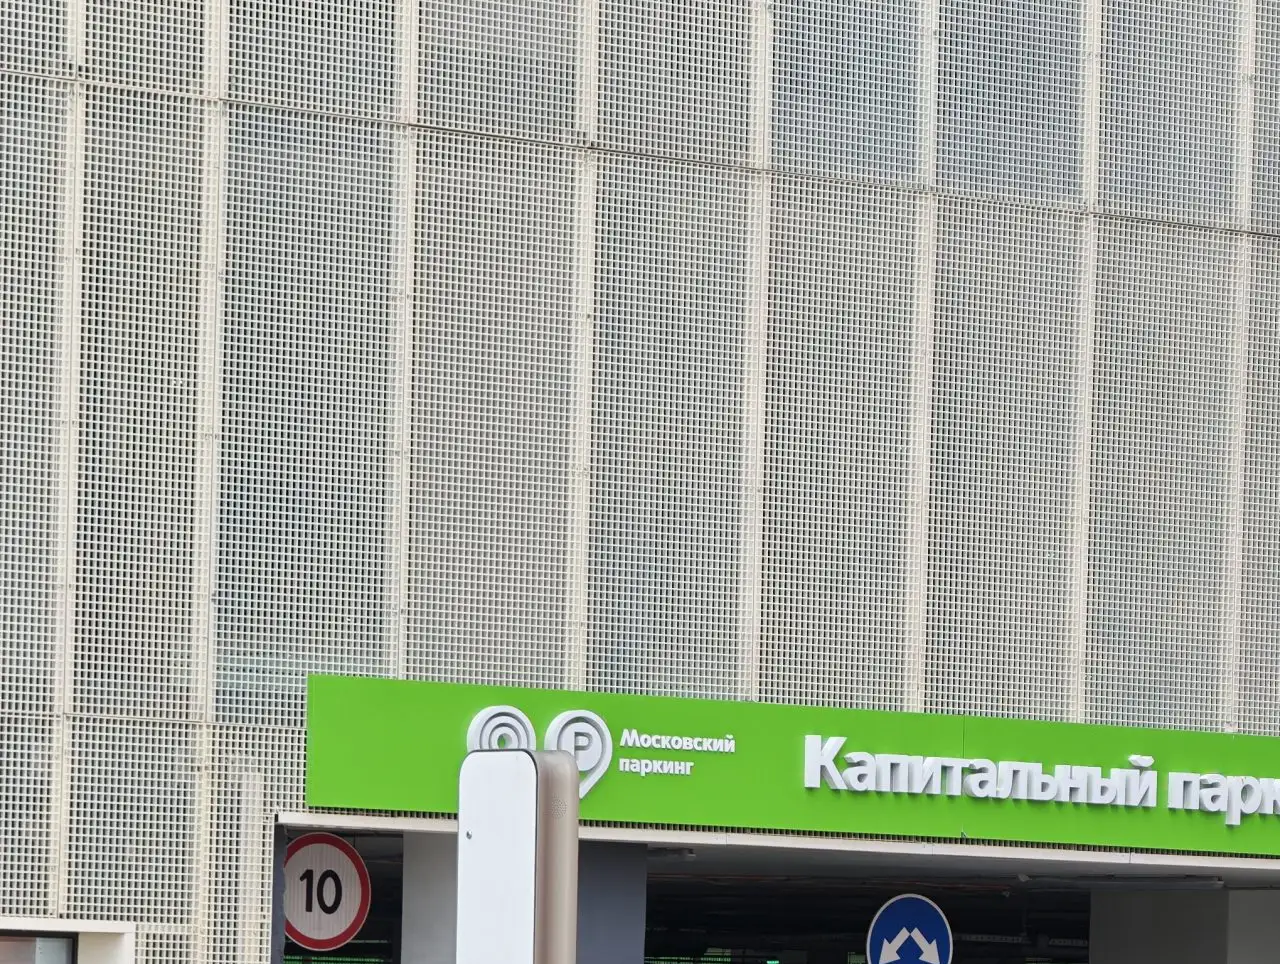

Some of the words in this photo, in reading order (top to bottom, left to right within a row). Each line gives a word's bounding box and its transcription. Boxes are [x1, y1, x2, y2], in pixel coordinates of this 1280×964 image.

[619, 728, 736, 754] Московский
[618, 757, 695, 777] паркинг
[804, 734, 1158, 808] Капитальный
[299, 868, 343, 915] 10
